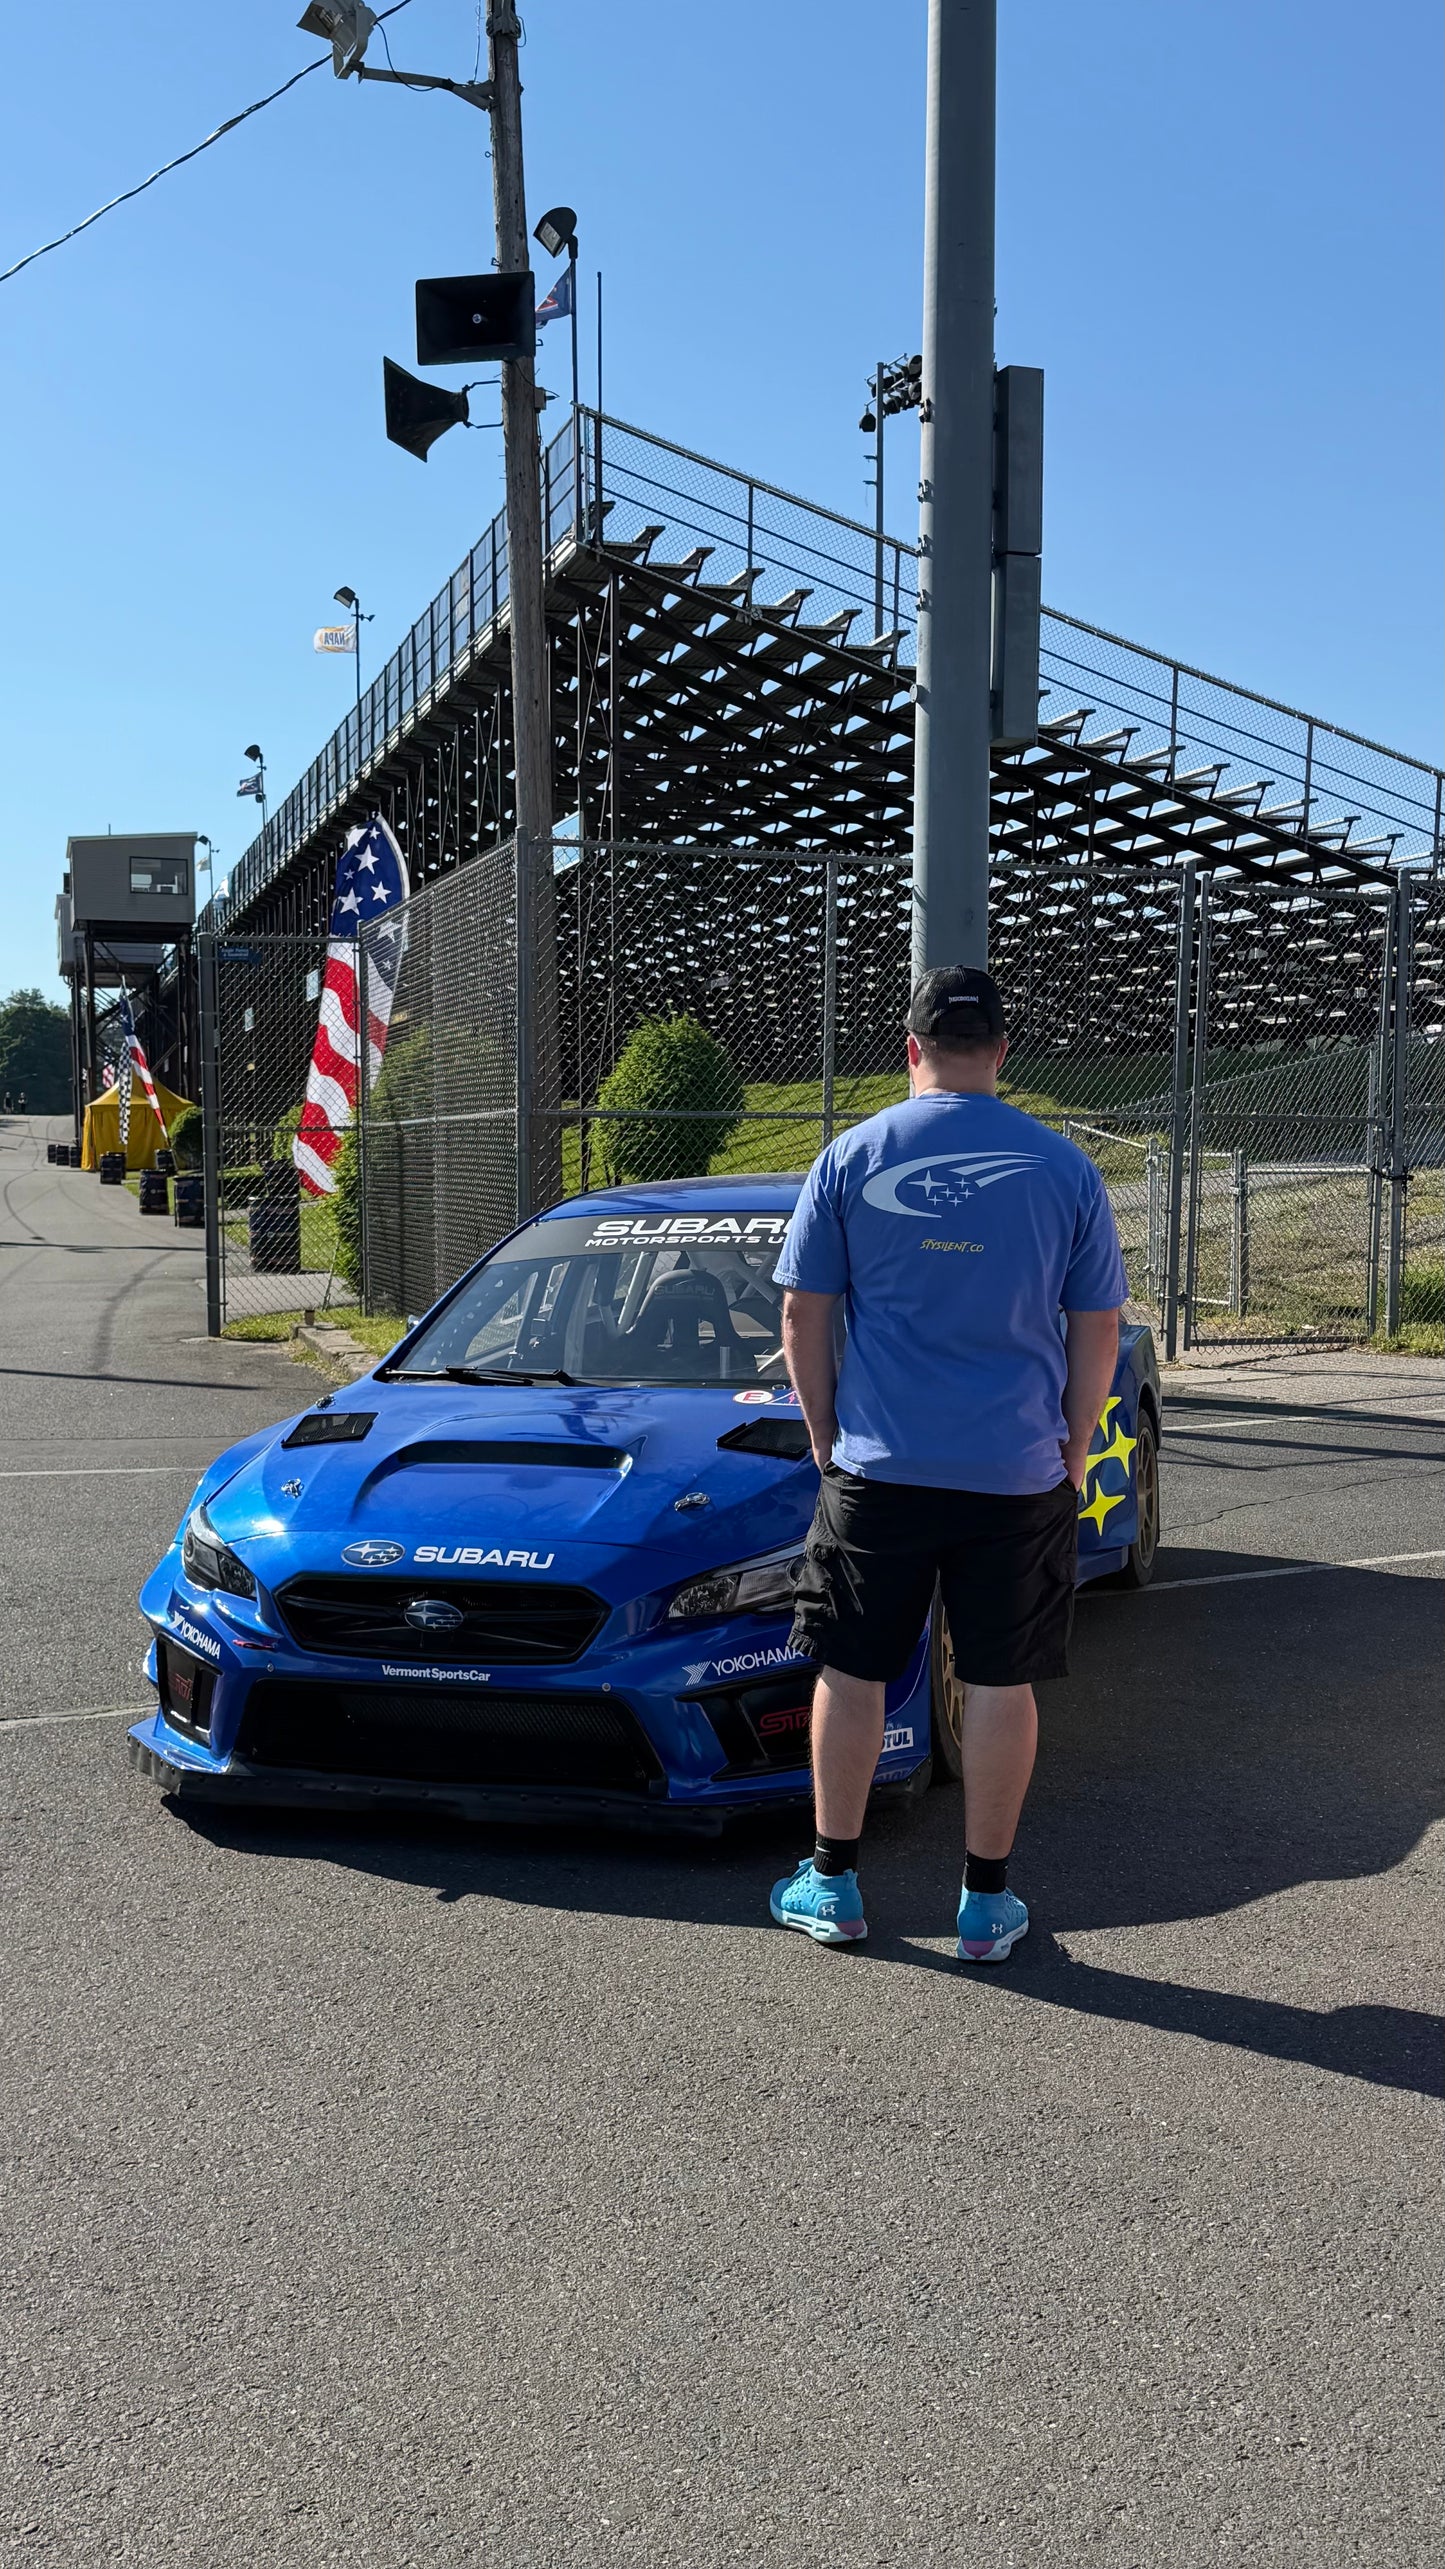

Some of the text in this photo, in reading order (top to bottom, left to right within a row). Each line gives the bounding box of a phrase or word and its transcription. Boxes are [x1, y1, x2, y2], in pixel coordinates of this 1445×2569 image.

[585, 1236, 762, 1247] MOTORSPORTS
[413, 1546, 555, 1569] SUBARU
[180, 1619, 221, 1660] YOKOHAMA
[884, 1731, 911, 1749] TUL
